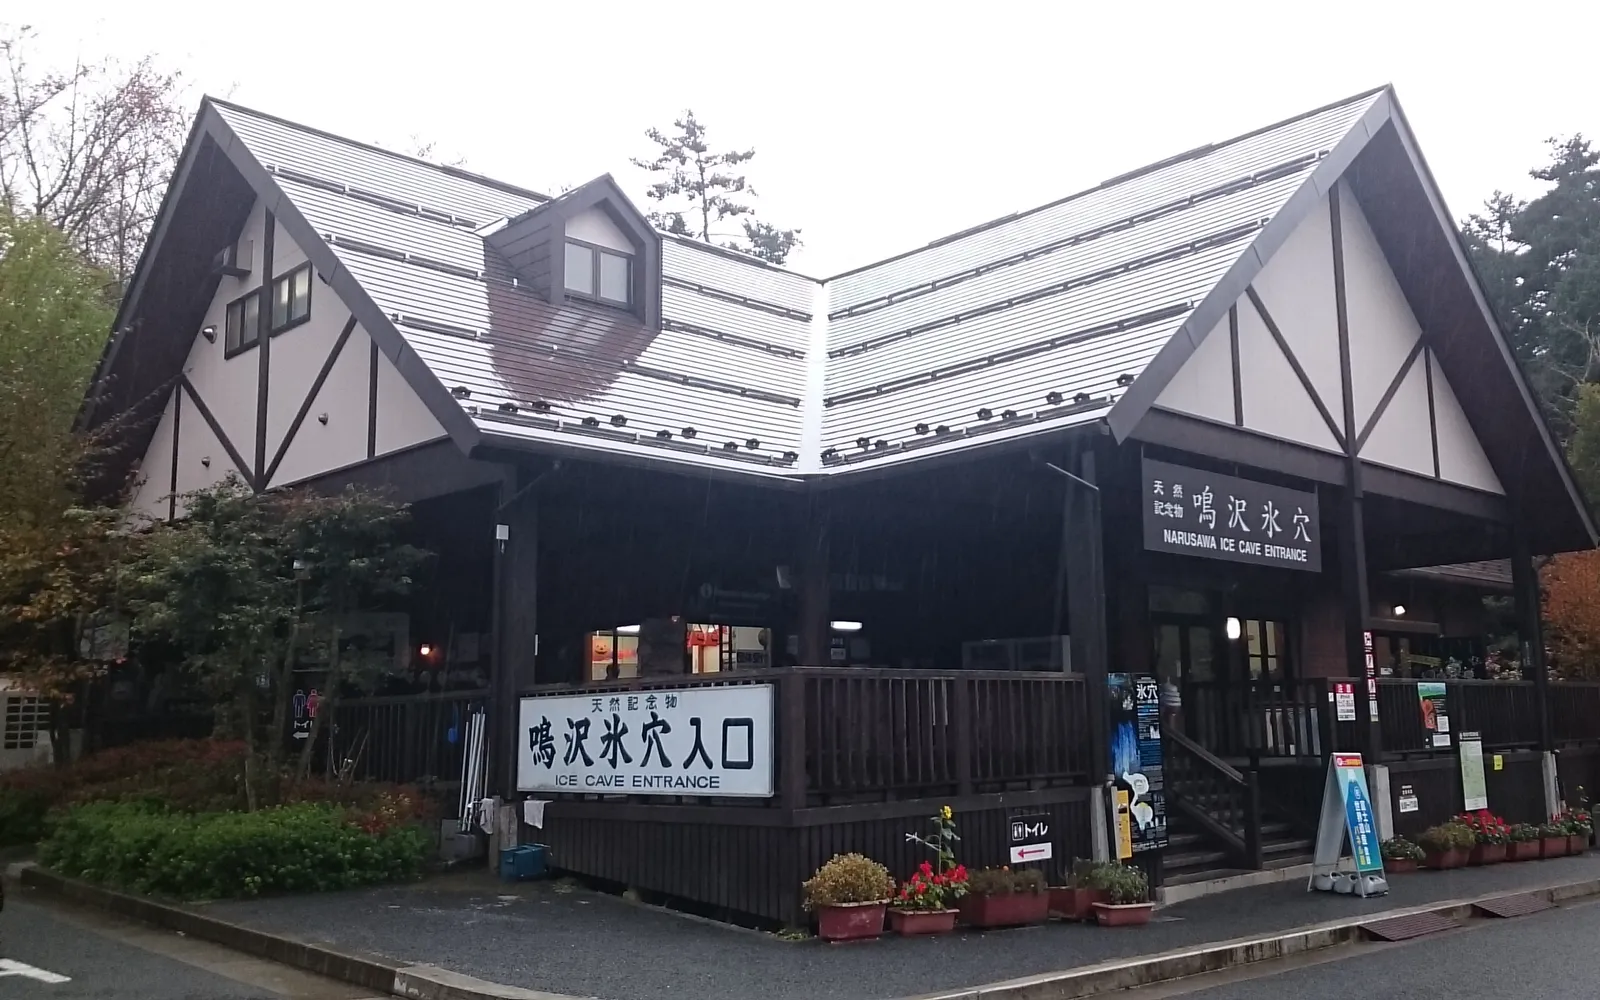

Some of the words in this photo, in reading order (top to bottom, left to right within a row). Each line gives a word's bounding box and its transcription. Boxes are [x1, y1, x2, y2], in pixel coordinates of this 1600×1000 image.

[1153, 480, 1183, 499] 天然
[1154, 500, 1184, 519] 記念物
[1192, 485, 1312, 543] 鳴沢氷穴
[1163, 529, 1217, 549] NARUSAWA
[1220, 537, 1235, 552] ICE
[1239, 540, 1262, 556] CAVE
[1264, 545, 1308, 562] ENTRANCE
[1136, 683, 1158, 700] 氷穴
[591, 694, 678, 713] 天然記念物
[528, 711, 755, 770] 鳴沢氷穴入口
[555, 774, 578, 786] ICE
[585, 774, 625, 787] CAVE
[632, 775, 721, 789] ENTRANCE
[1024, 822, 1049, 838] トイレ
